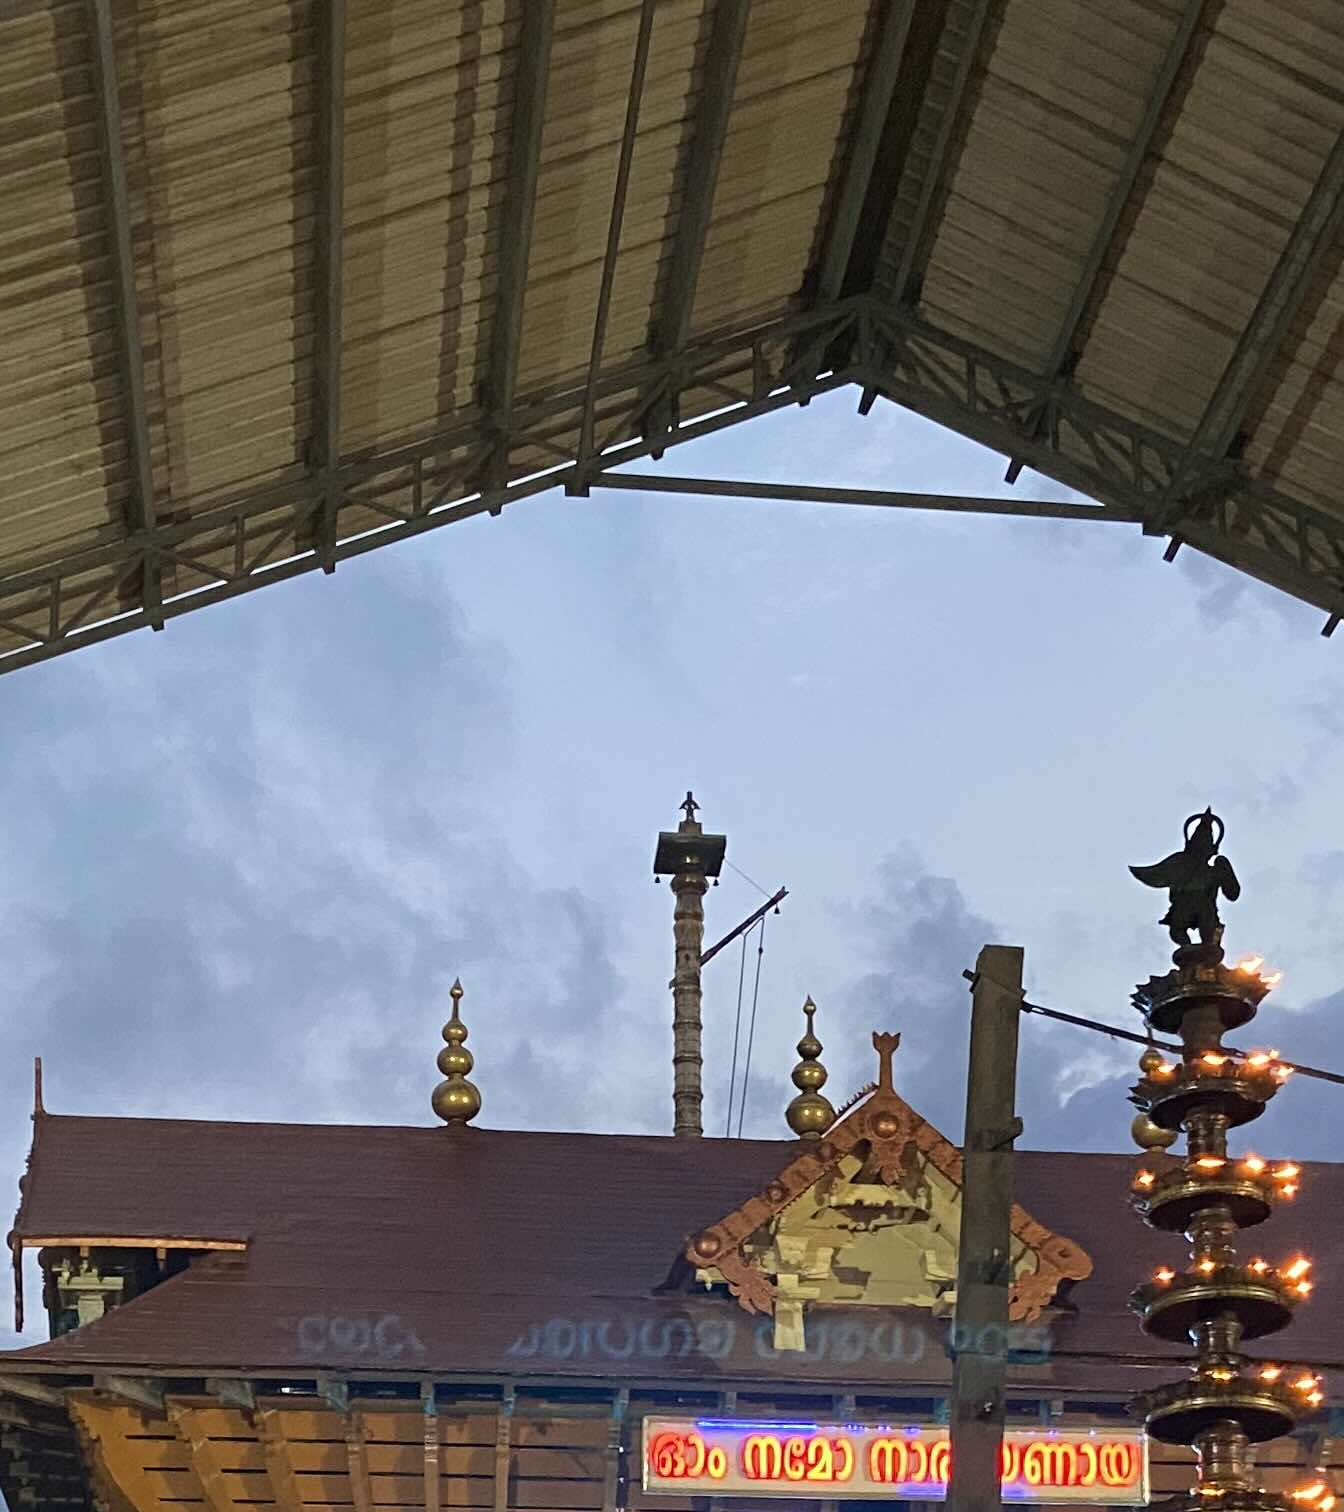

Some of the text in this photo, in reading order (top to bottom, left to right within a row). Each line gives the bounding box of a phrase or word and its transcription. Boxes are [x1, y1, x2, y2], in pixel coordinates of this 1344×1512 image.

[654, 1433, 1141, 1487] ഓം നമോ നാരണായ
